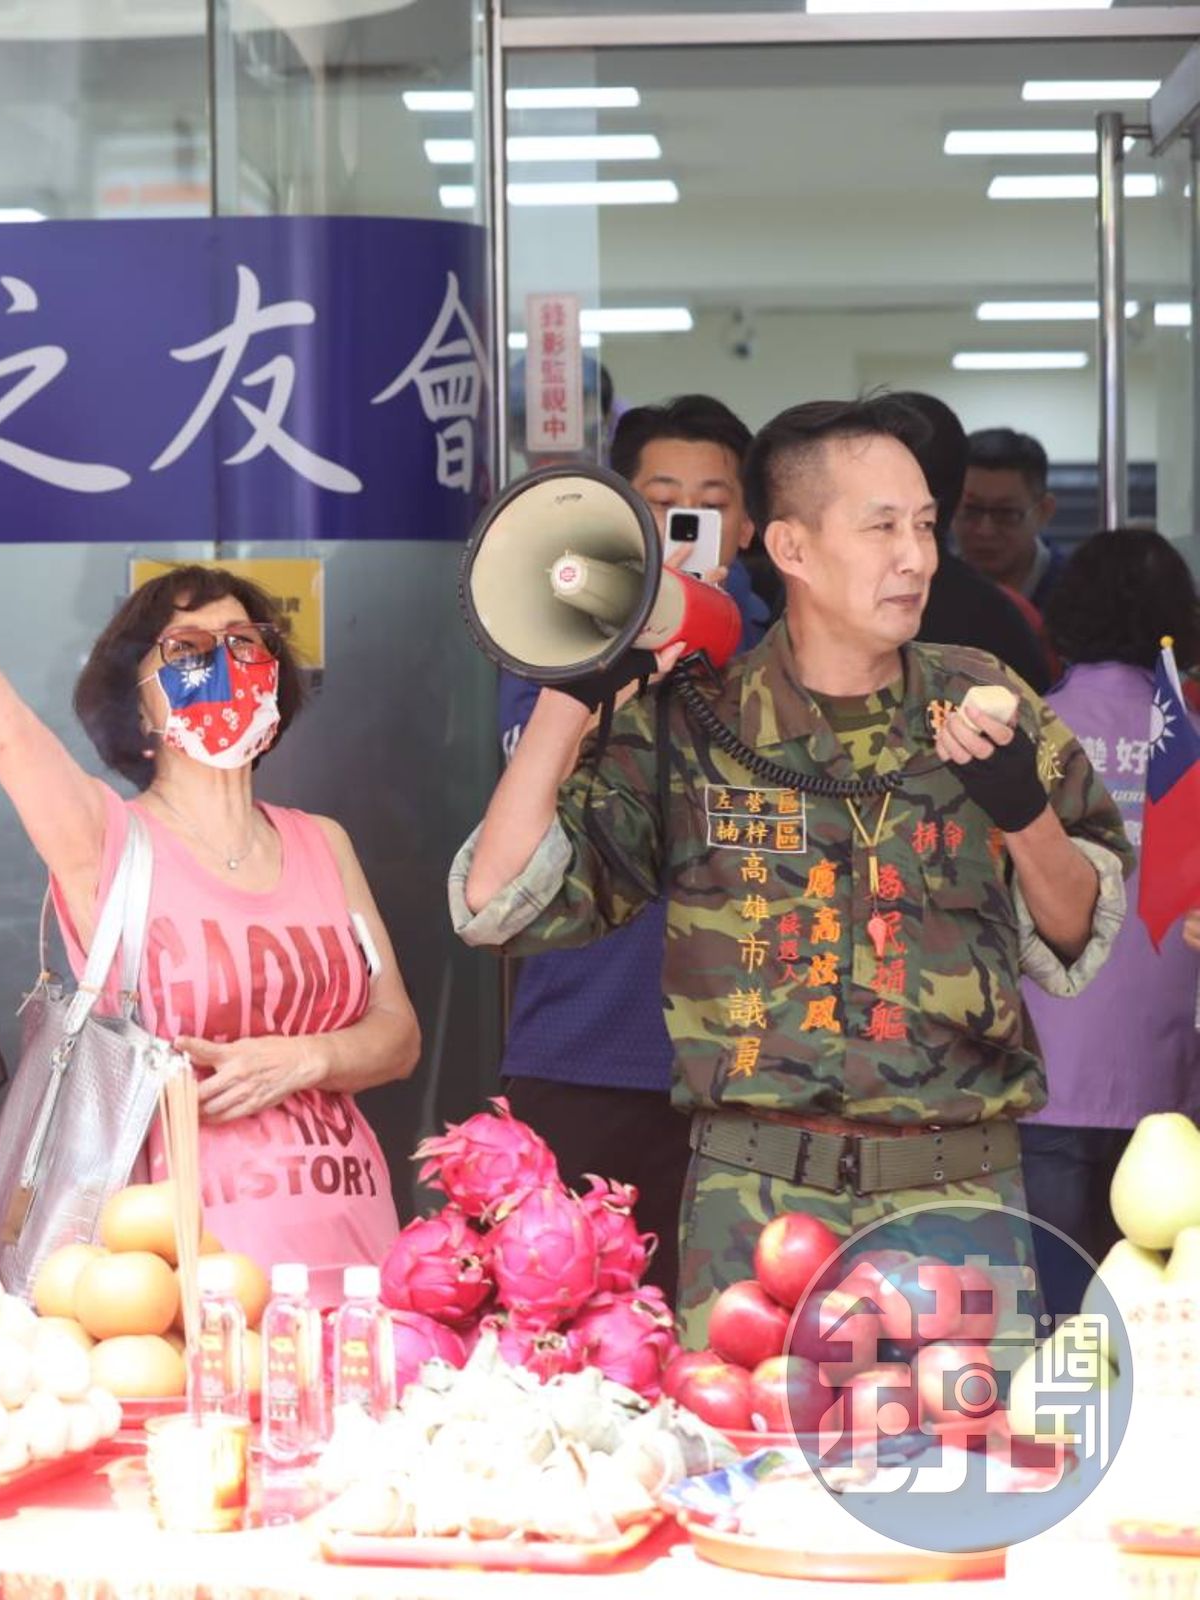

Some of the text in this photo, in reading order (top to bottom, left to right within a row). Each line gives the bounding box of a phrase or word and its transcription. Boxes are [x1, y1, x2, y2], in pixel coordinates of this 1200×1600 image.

[715, 788, 800, 814] 左營區
[715, 819, 801, 849] 楠梓區
[728, 852, 771, 1077] 高雄市議員
